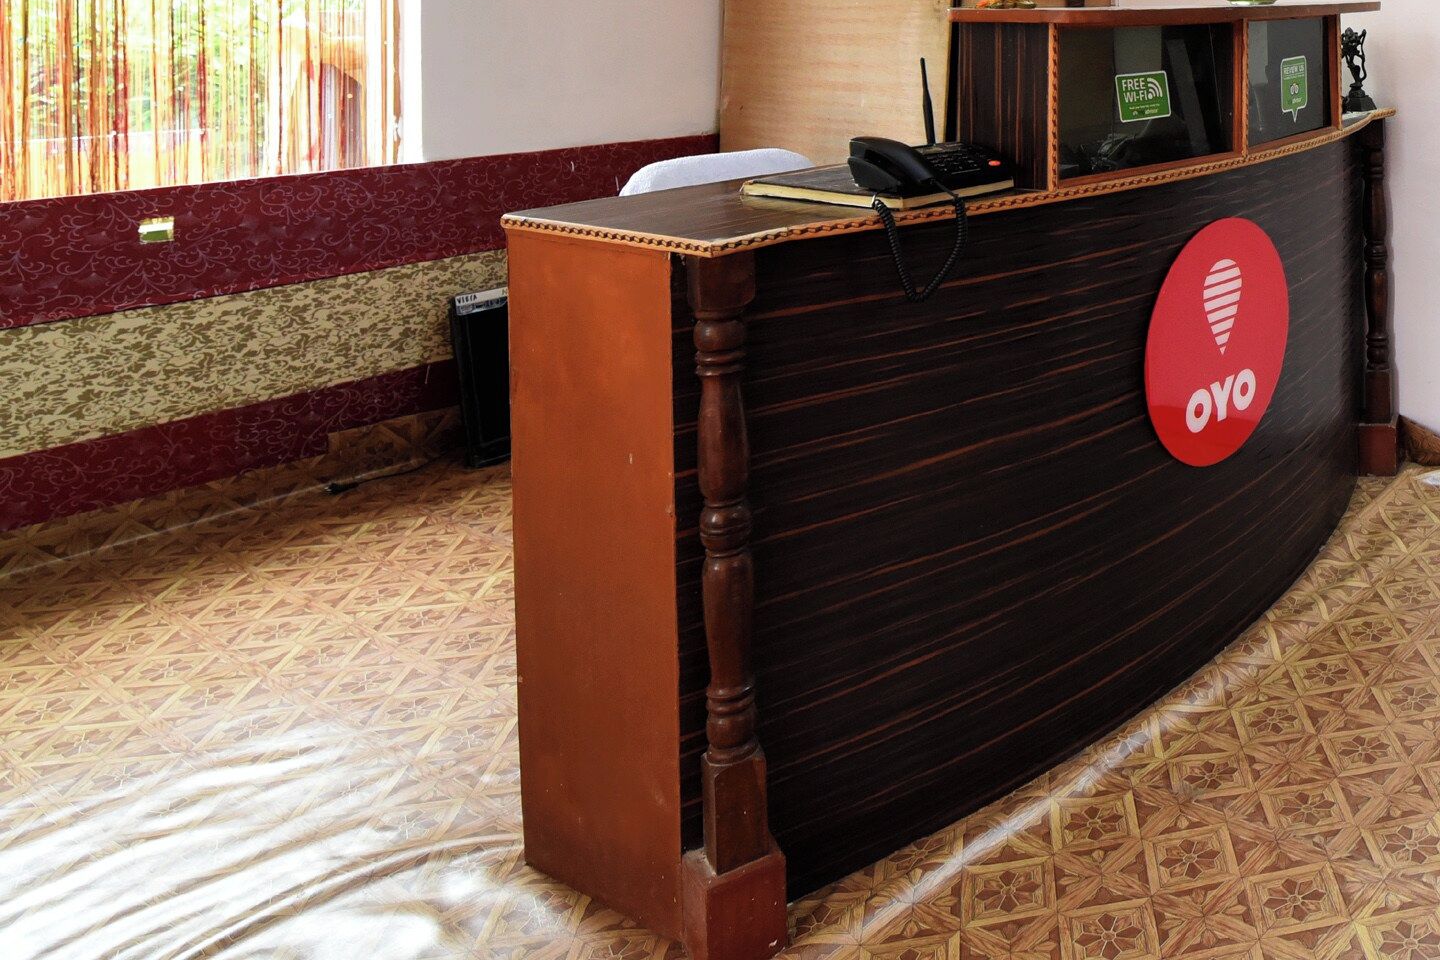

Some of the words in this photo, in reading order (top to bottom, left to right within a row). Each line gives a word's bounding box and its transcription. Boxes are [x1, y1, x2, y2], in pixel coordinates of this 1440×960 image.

[1121, 77, 1146, 92] FREE
[1123, 90, 1148, 103] WI-FI
[1185, 368, 1256, 434] OYO
